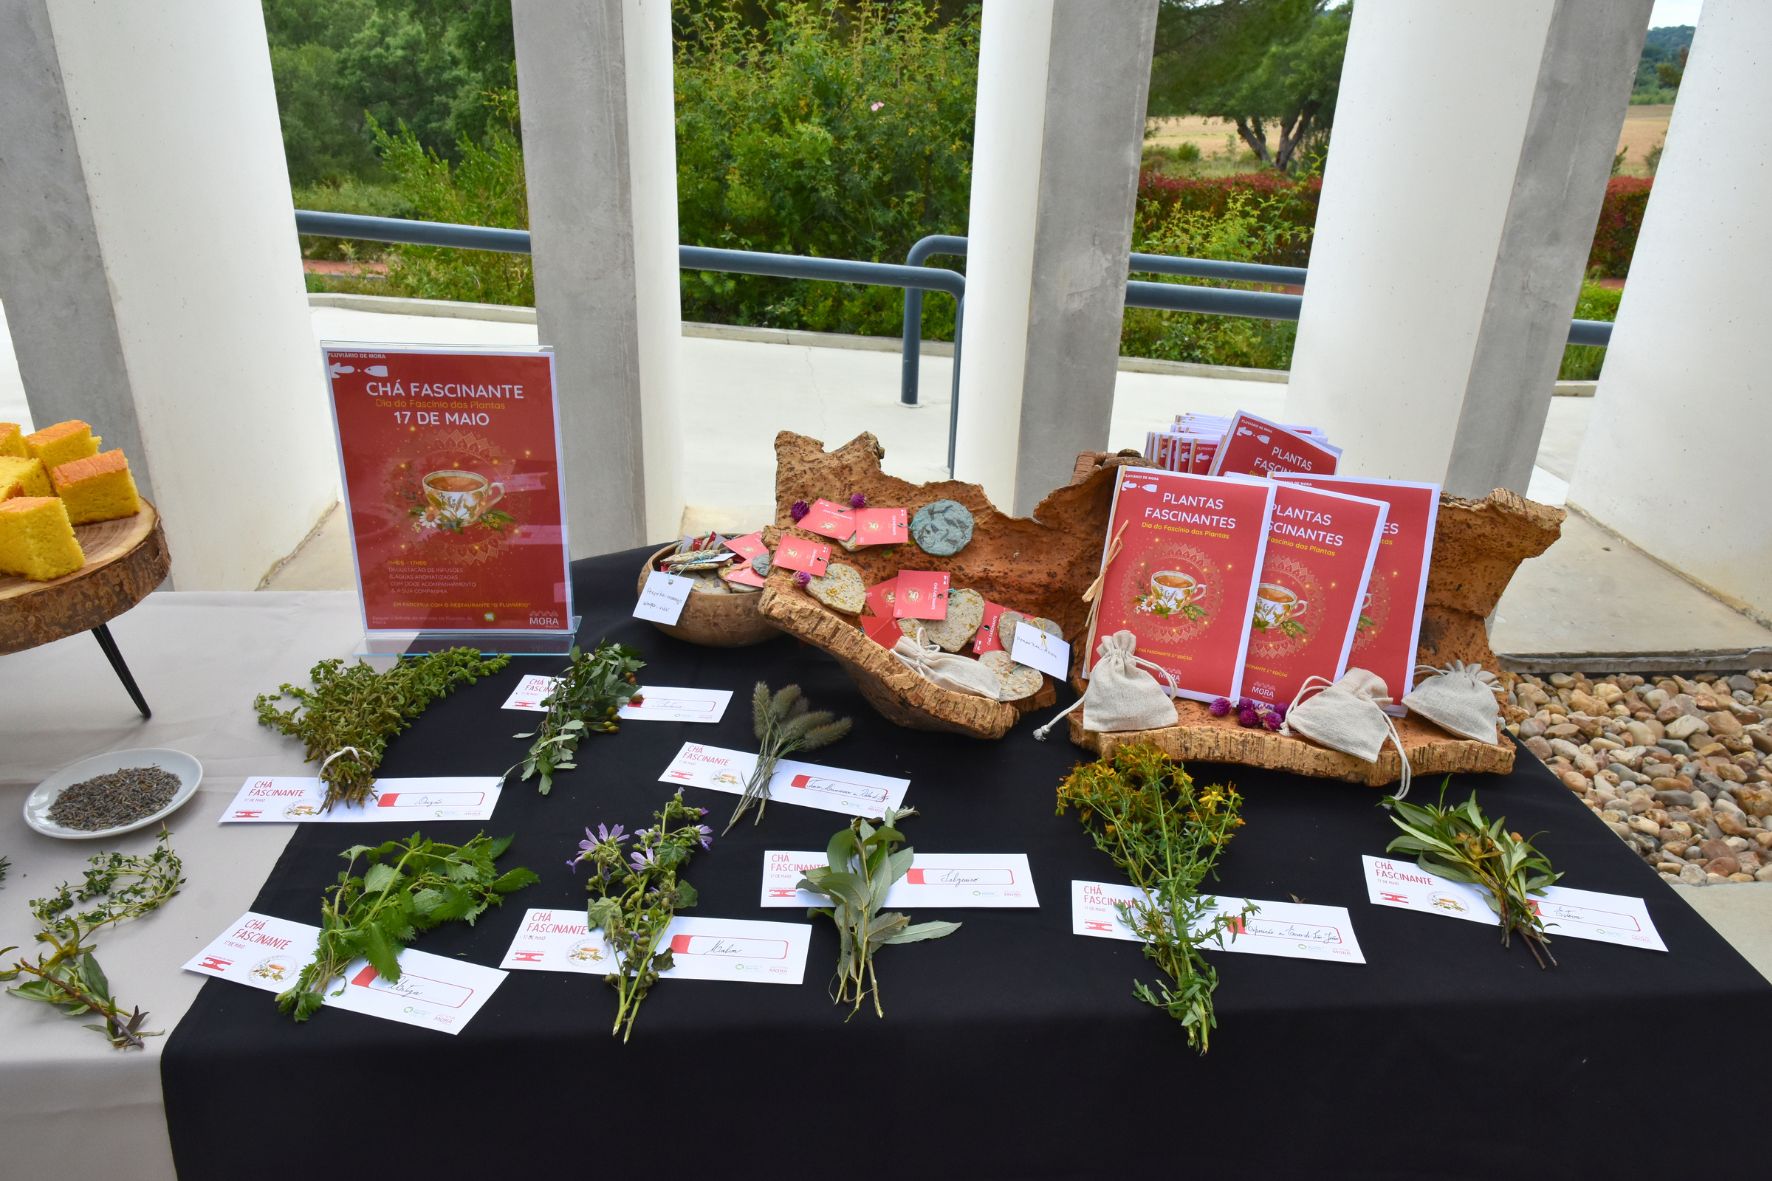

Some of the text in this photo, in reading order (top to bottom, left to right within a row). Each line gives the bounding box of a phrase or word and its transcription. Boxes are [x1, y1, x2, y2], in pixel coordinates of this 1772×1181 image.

[366, 379, 524, 399] CHÁ FASCINANTE
[375, 399, 506, 410] Dia do Fascínio das Plantas
[394, 411, 490, 426] 17 DE MAIO
[1272, 446, 1312, 472] PLANTAS
[1162, 492, 1224, 510] PLANTAS
[1144, 507, 1236, 529] FASCINANTES
[1164, 524, 1190, 534] Fascínio
[1190, 528, 1204, 536] das
[1204, 530, 1230, 540] Plantas
[1268, 520, 1344, 546] SCINANTES
[1268, 536, 1336, 557] ascínio das Plantas
[529, 617, 560, 626] MORA
[1252, 686, 1274, 698] MORA
[688, 744, 705, 754] CHÁ
[682, 752, 729, 766] FASCINANTE
[254, 779, 274, 788] CHÁ
[248, 788, 304, 797] FASCINANTE
[772, 852, 790, 862] CHÁ
[1375, 860, 1394, 870] CHÁ
[1376, 870, 1433, 886] FASCINANTE
[1084, 884, 1102, 895] CHÁ
[532, 910, 552, 922] CHÁ
[244, 919, 268, 931] CHÁ
[526, 922, 588, 935] FASCINANTE
[232, 928, 292, 950] FASCINANTE
